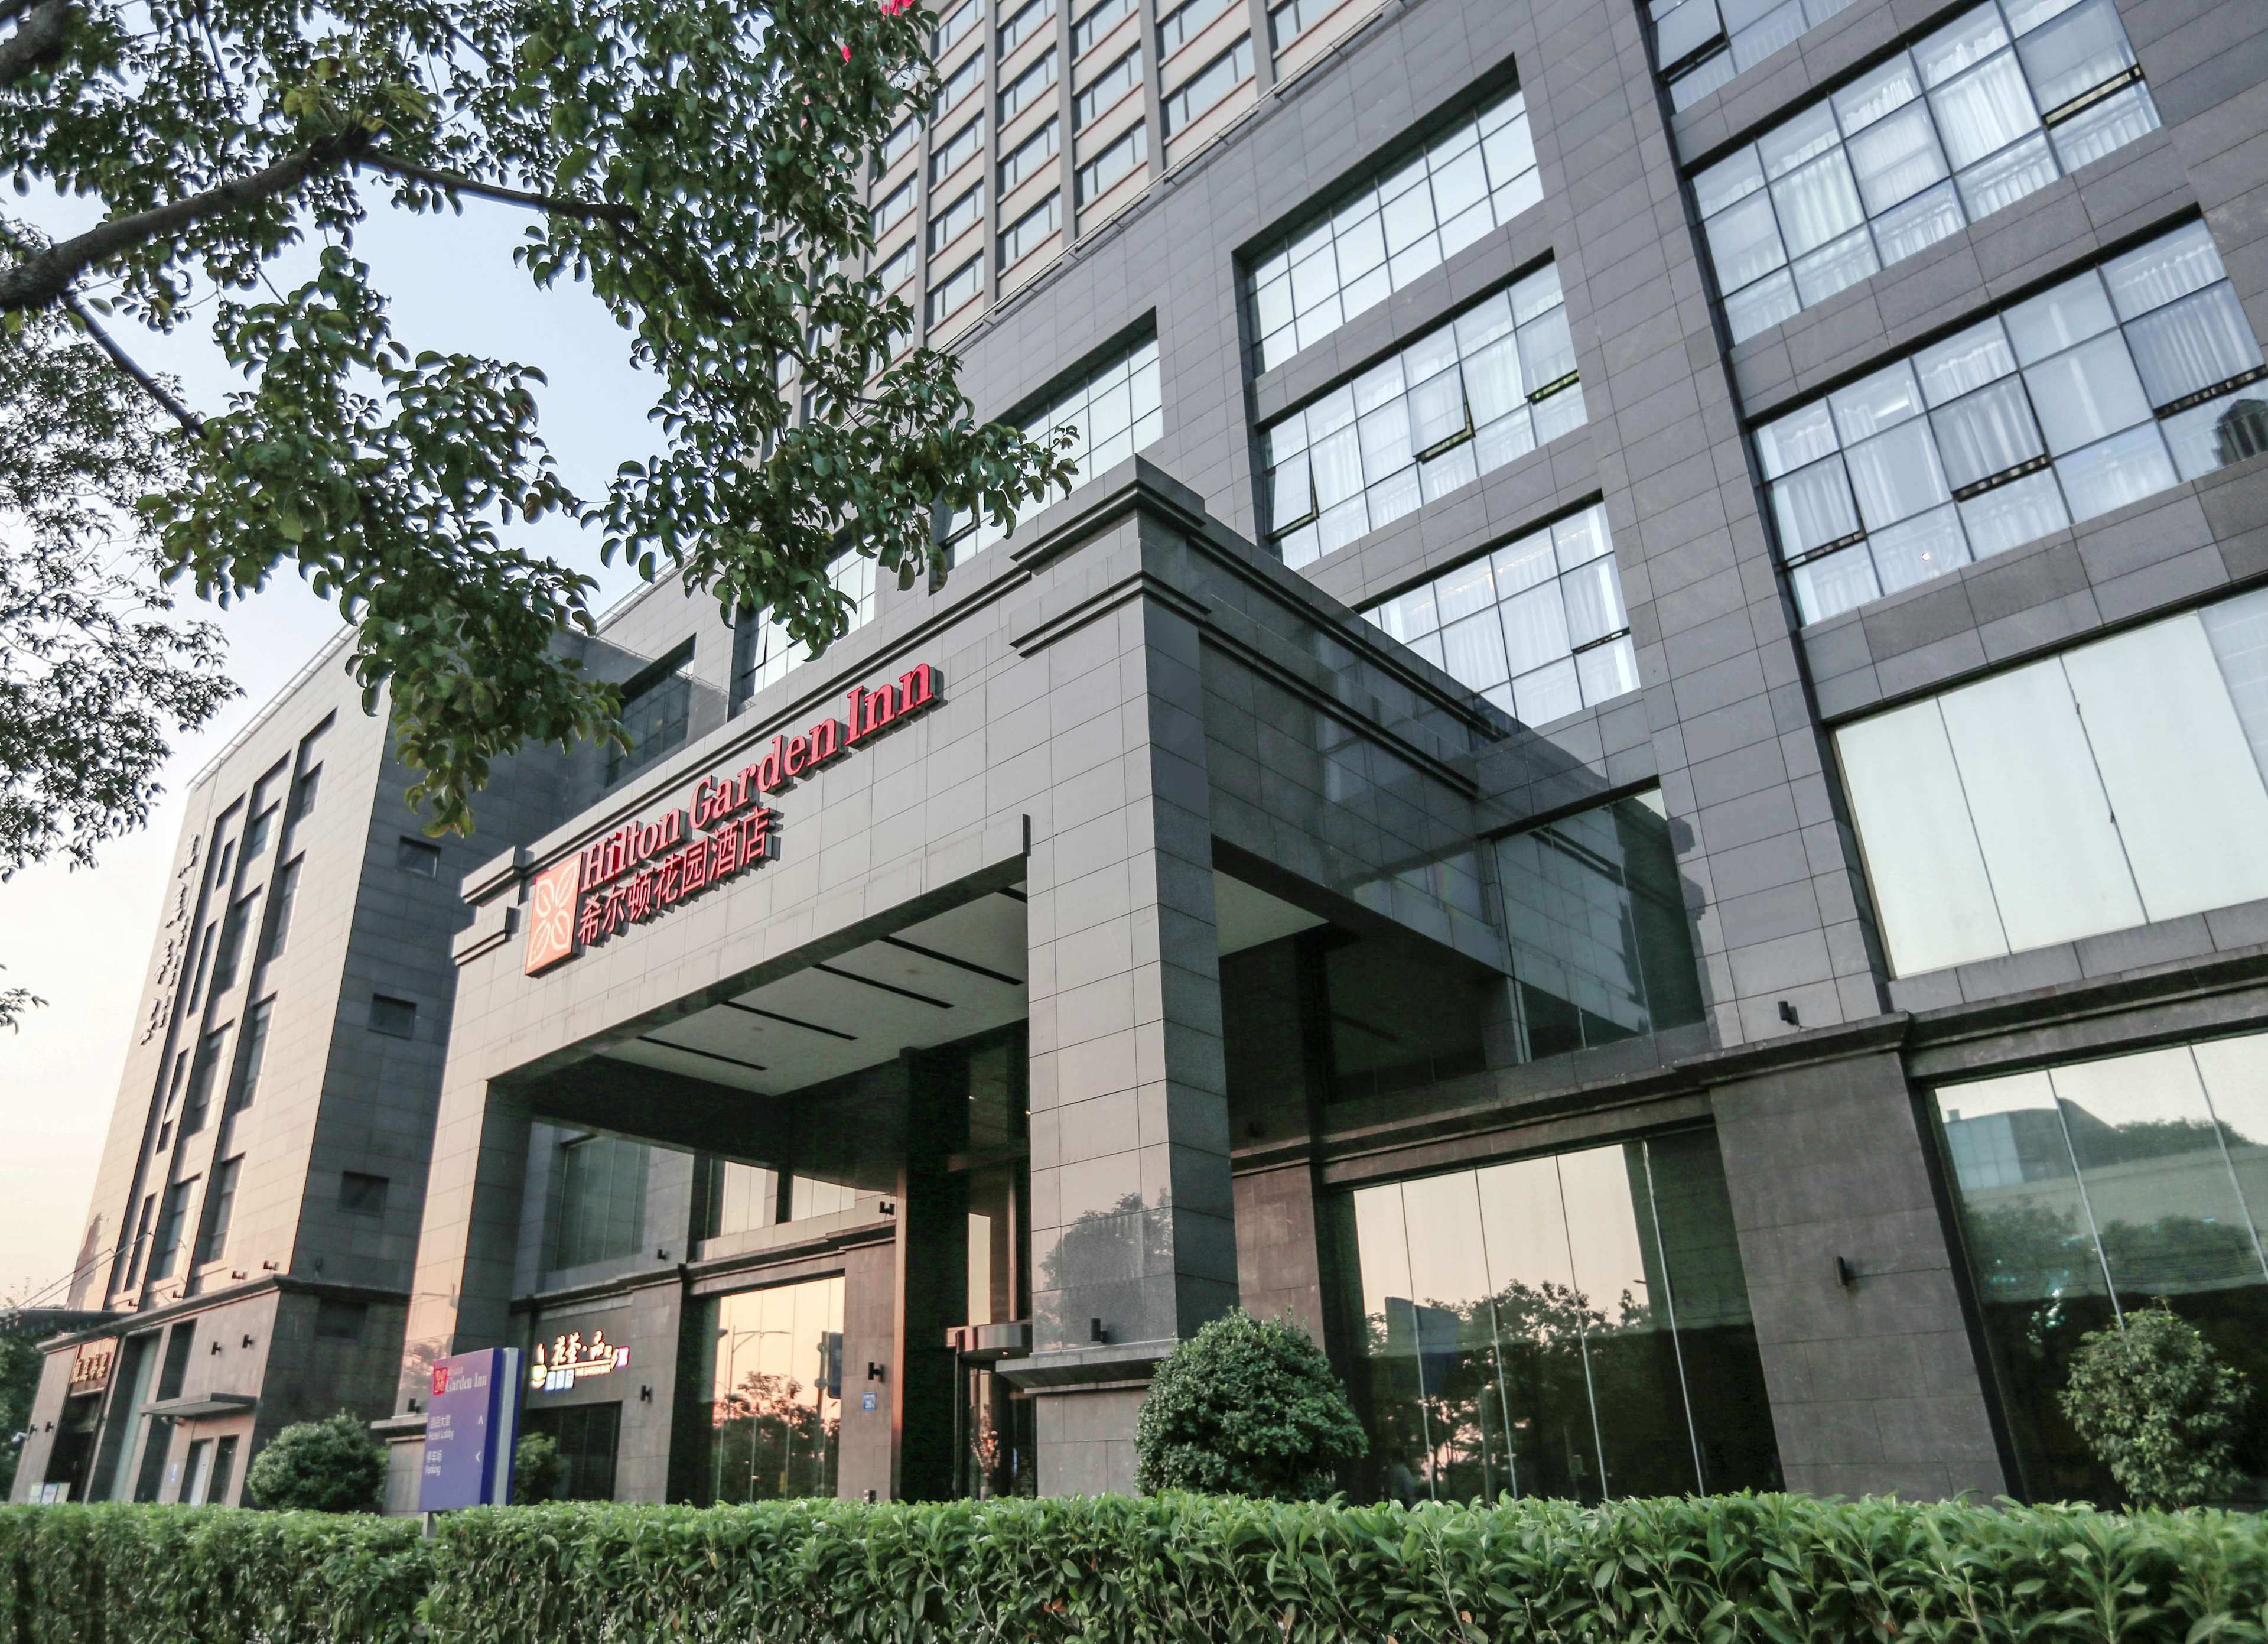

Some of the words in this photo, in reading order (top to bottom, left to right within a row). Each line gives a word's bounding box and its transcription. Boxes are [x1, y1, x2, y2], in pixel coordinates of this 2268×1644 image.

[580, 807, 682, 893] Hilton
[688, 717, 839, 830] Garden
[845, 662, 936, 747] Inn
[578, 805, 772, 944] 希尔顿花园酒店
[446, 1375, 473, 1393] Garden
[474, 1372, 487, 1388] Inn
